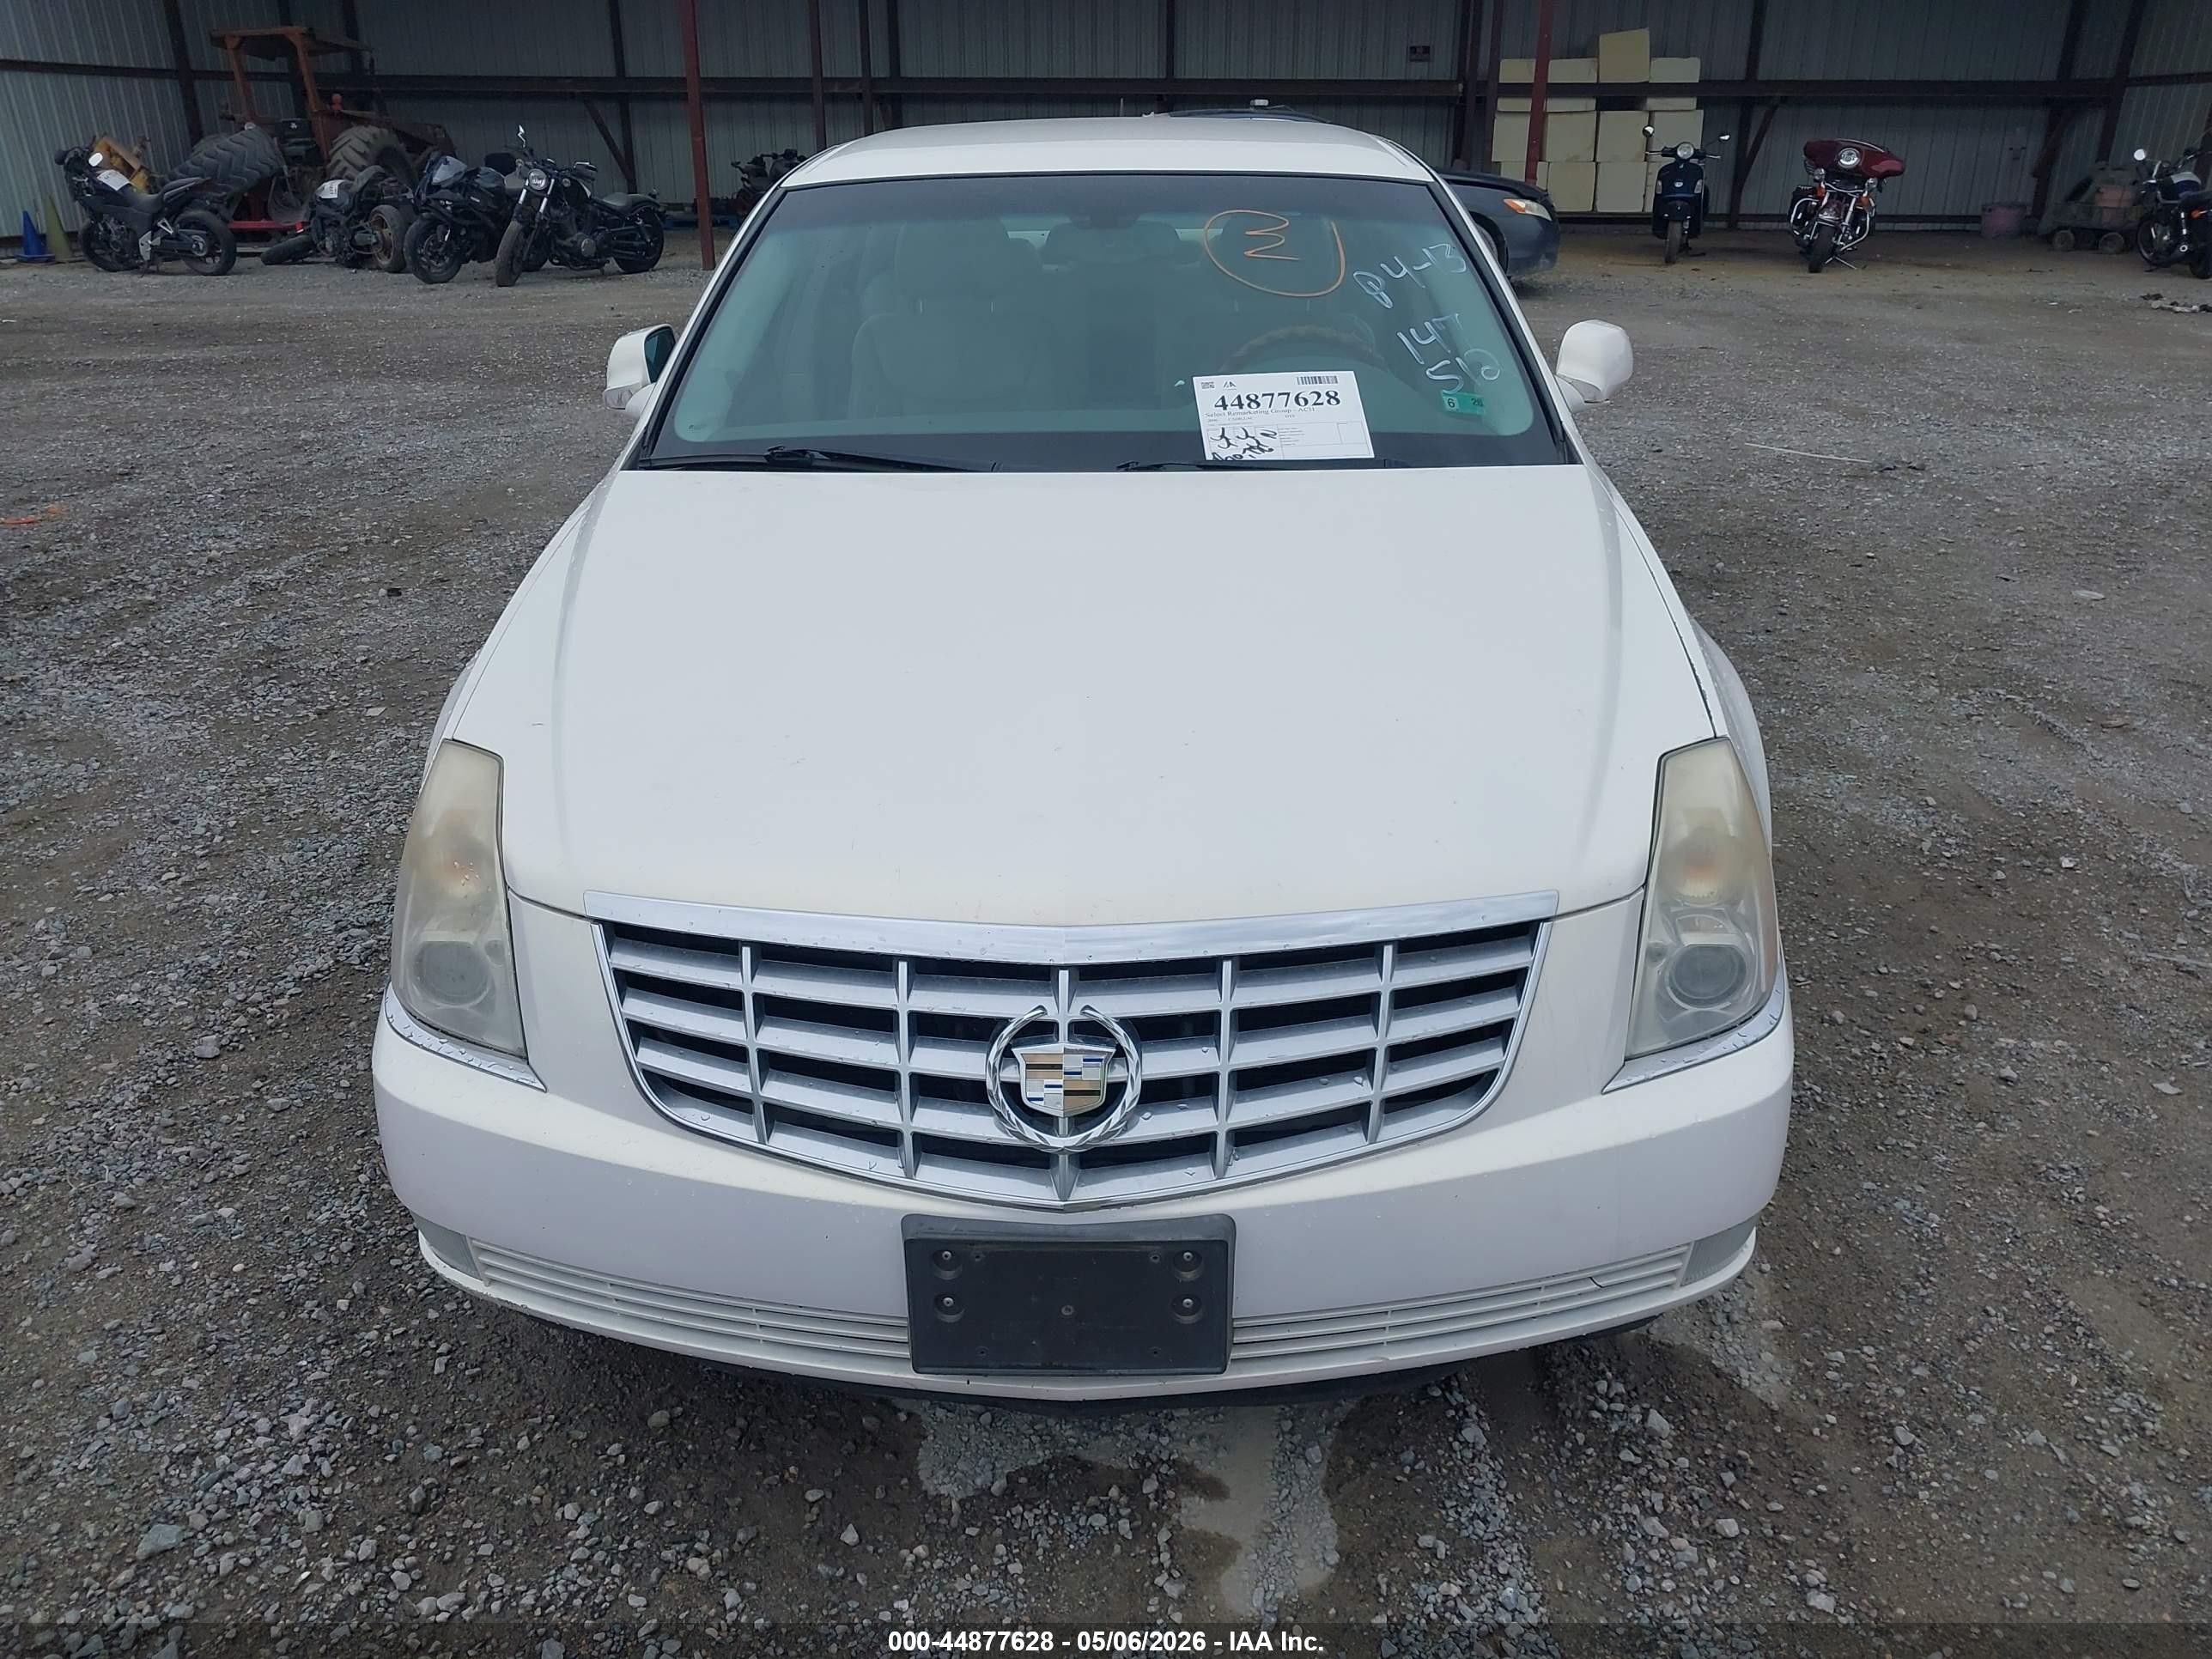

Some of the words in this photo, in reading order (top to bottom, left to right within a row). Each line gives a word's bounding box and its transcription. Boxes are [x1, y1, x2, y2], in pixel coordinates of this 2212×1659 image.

[1213, 390, 1341, 411] 44877628
[1447, 398, 1455, 408] 6
[1228, 409, 1269, 417] Remarketing
